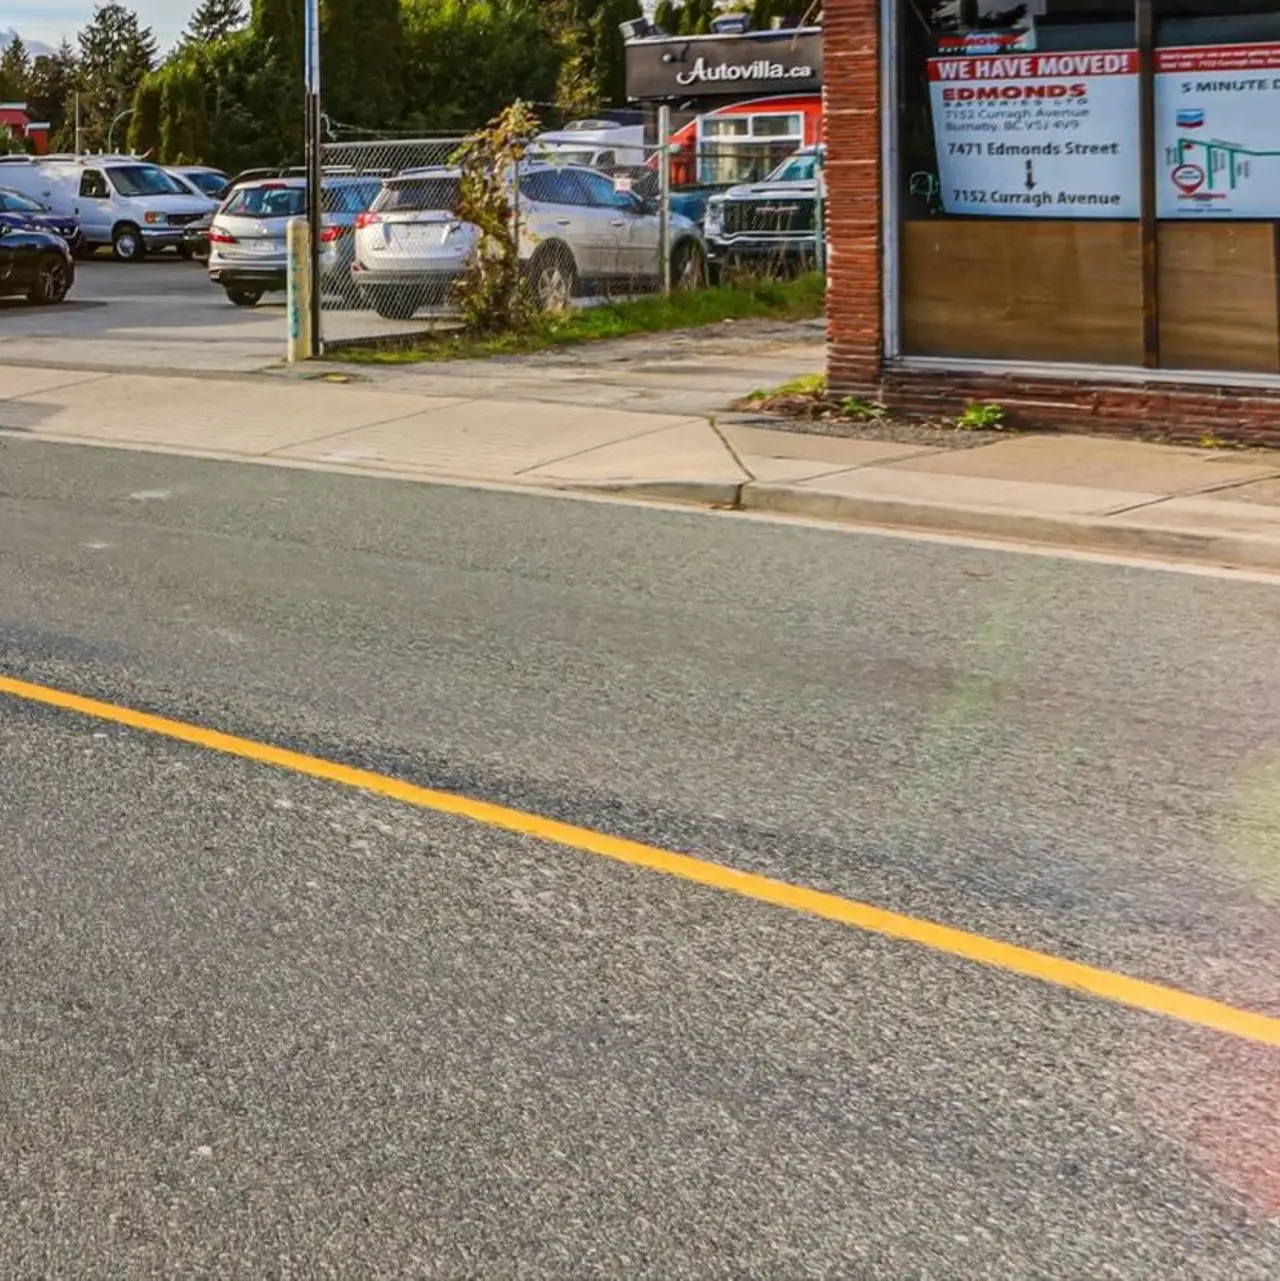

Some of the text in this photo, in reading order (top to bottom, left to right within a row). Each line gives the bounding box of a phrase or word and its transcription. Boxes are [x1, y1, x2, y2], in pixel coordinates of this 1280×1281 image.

[676, 57, 812, 84] Autovilla.ca
[938, 54, 1128, 79] WE HAVE MOVED!
[942, 84, 1087, 100] EDMONDS
[1181, 82, 1192, 93] 5
[1195, 78, 1269, 92] MINUTE
[1037, 108, 1090, 117] Avenue
[948, 141, 1120, 155] 7471 Edmonds Street
[953, 189, 1121, 207] 7152 Curragh Avenue
